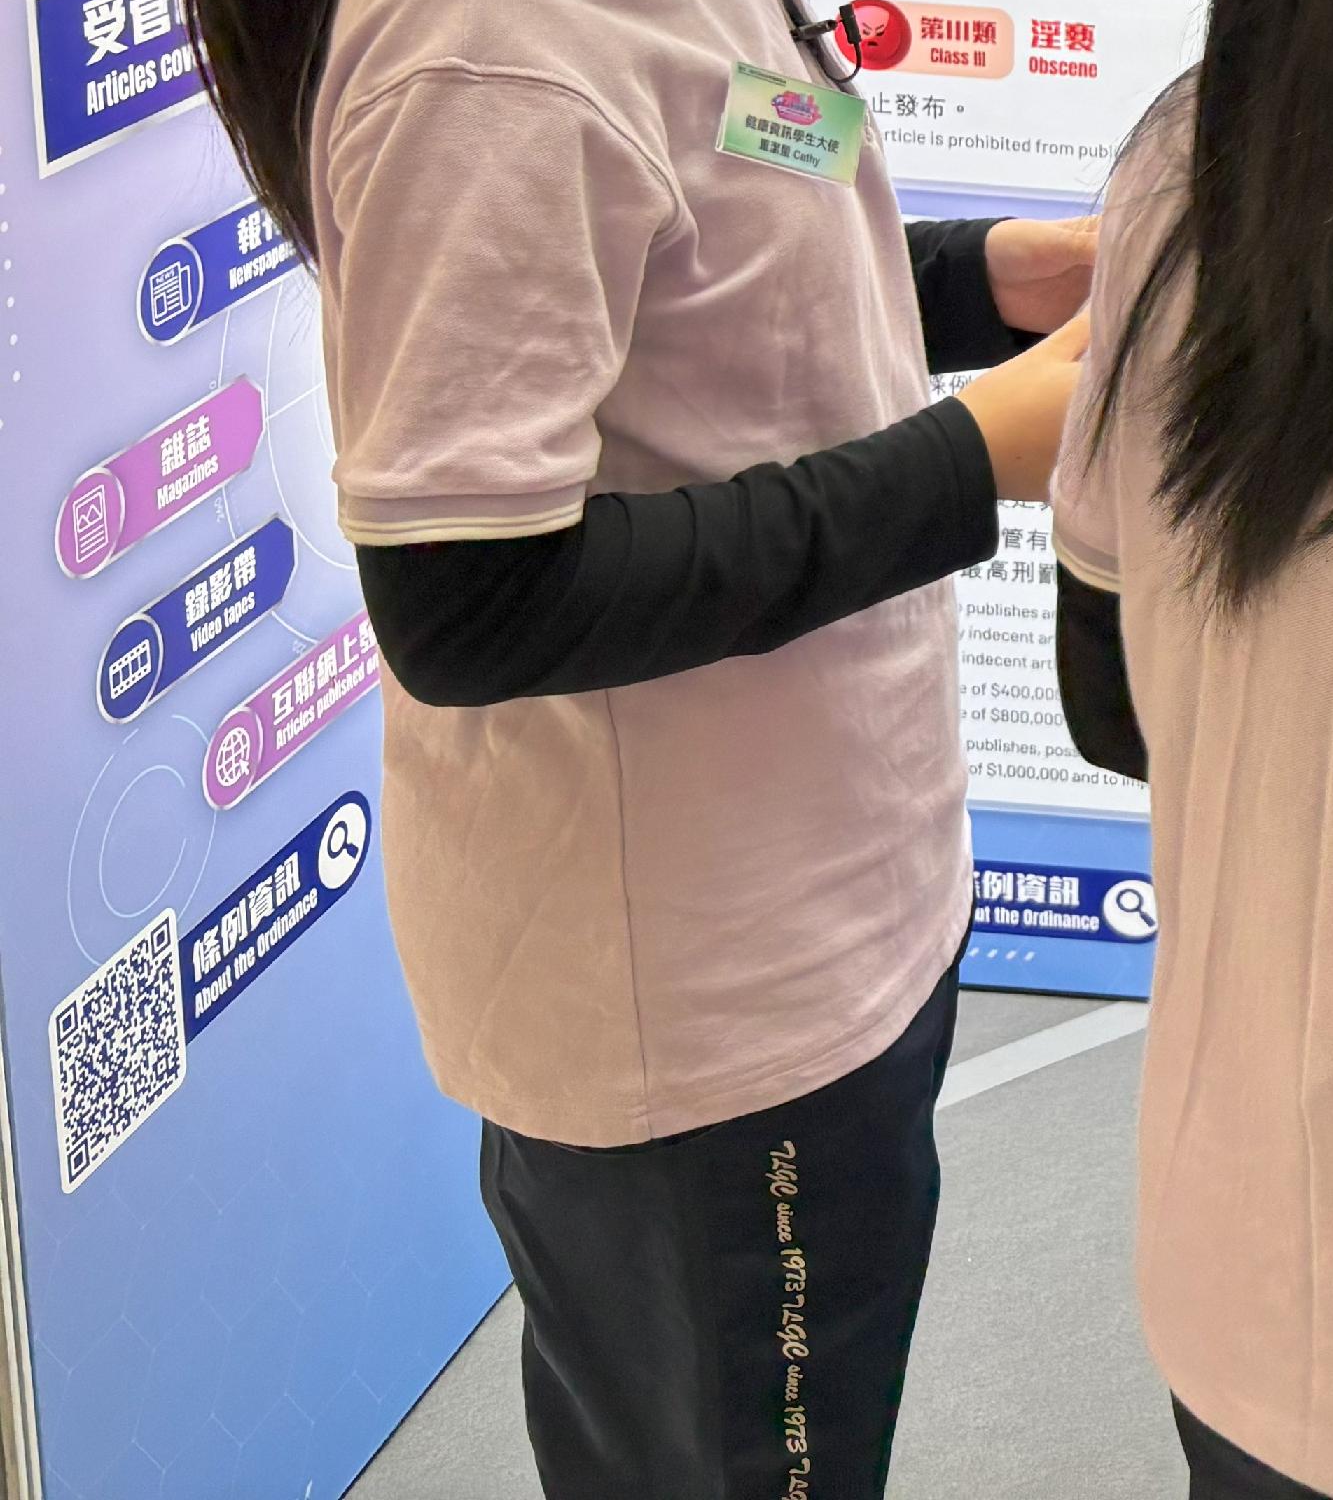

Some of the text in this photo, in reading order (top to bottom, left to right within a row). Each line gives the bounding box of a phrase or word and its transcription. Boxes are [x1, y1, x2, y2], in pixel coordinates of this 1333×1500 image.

[920, 15, 998, 46] 第III類
[1030, 18, 1096, 53] 淫褻
[931, 47, 985, 67] Class III
[1028, 55, 1099, 79] Obscene
[87, 60, 157, 116] Articles
[793, 149, 821, 168] Cathy
[160, 414, 212, 477] 雜誌
[157, 454, 219, 510] Magazines
[185, 546, 256, 628] 錄影帶
[190, 591, 255, 652] Video tapes
[276, 664, 364, 751] Articles published
[991, 707, 1063, 726] $800,000
[986, 763, 1118, 785] $1,000,000 and to
[193, 851, 301, 983] 條例資訊
[994, 907, 1100, 931] the Ordinance
[195, 887, 318, 1019] About the Ordinance
[776, 1202, 794, 1244] since
[780, 1247, 805, 1293] 1973
